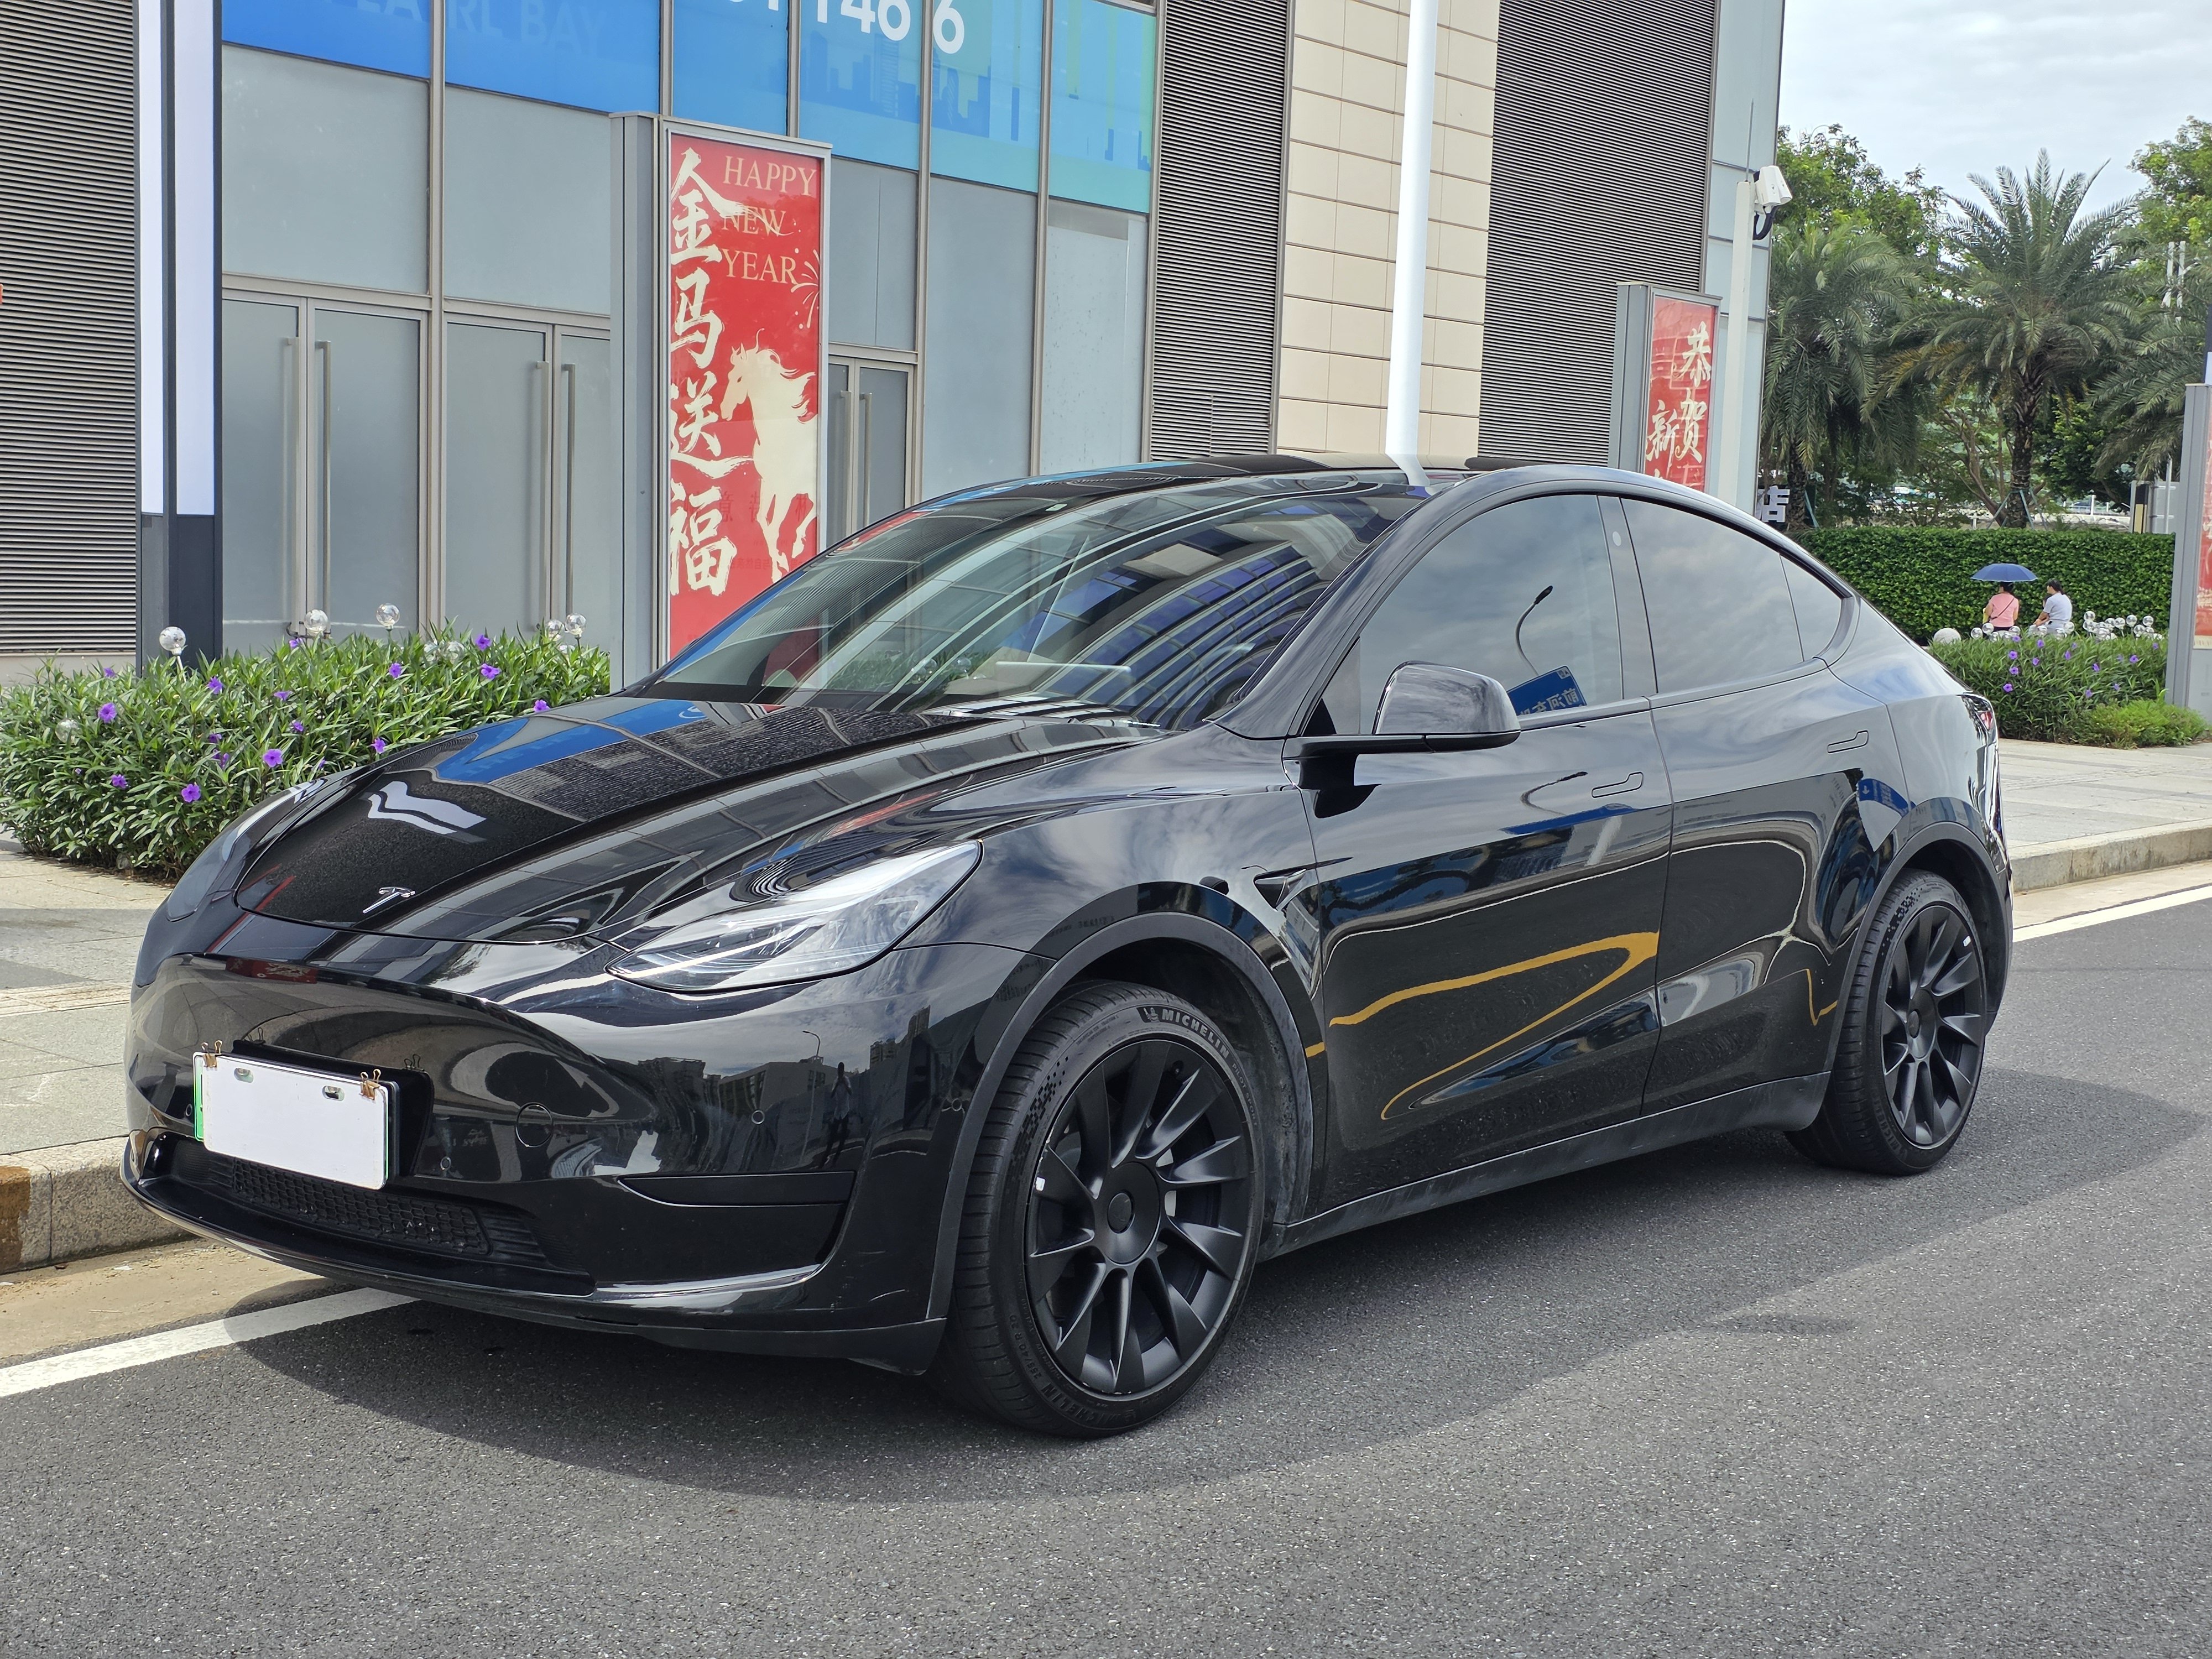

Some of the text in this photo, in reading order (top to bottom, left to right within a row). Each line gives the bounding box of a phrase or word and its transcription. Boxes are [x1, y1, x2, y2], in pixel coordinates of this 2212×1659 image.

[521, 0, 607, 58] BAY
[723, 155, 817, 196] HAPPY
[722, 206, 786, 237] NEW
[721, 248, 798, 284] YEAR
[670, 147, 763, 596] 金马送福
[1674, 321, 1712, 463] 恭贺
[1646, 399, 1679, 480] 新
[1755, 485, 1790, 523] 店
[1162, 1008, 1258, 1126] MICHELIN PILOT SPORT
